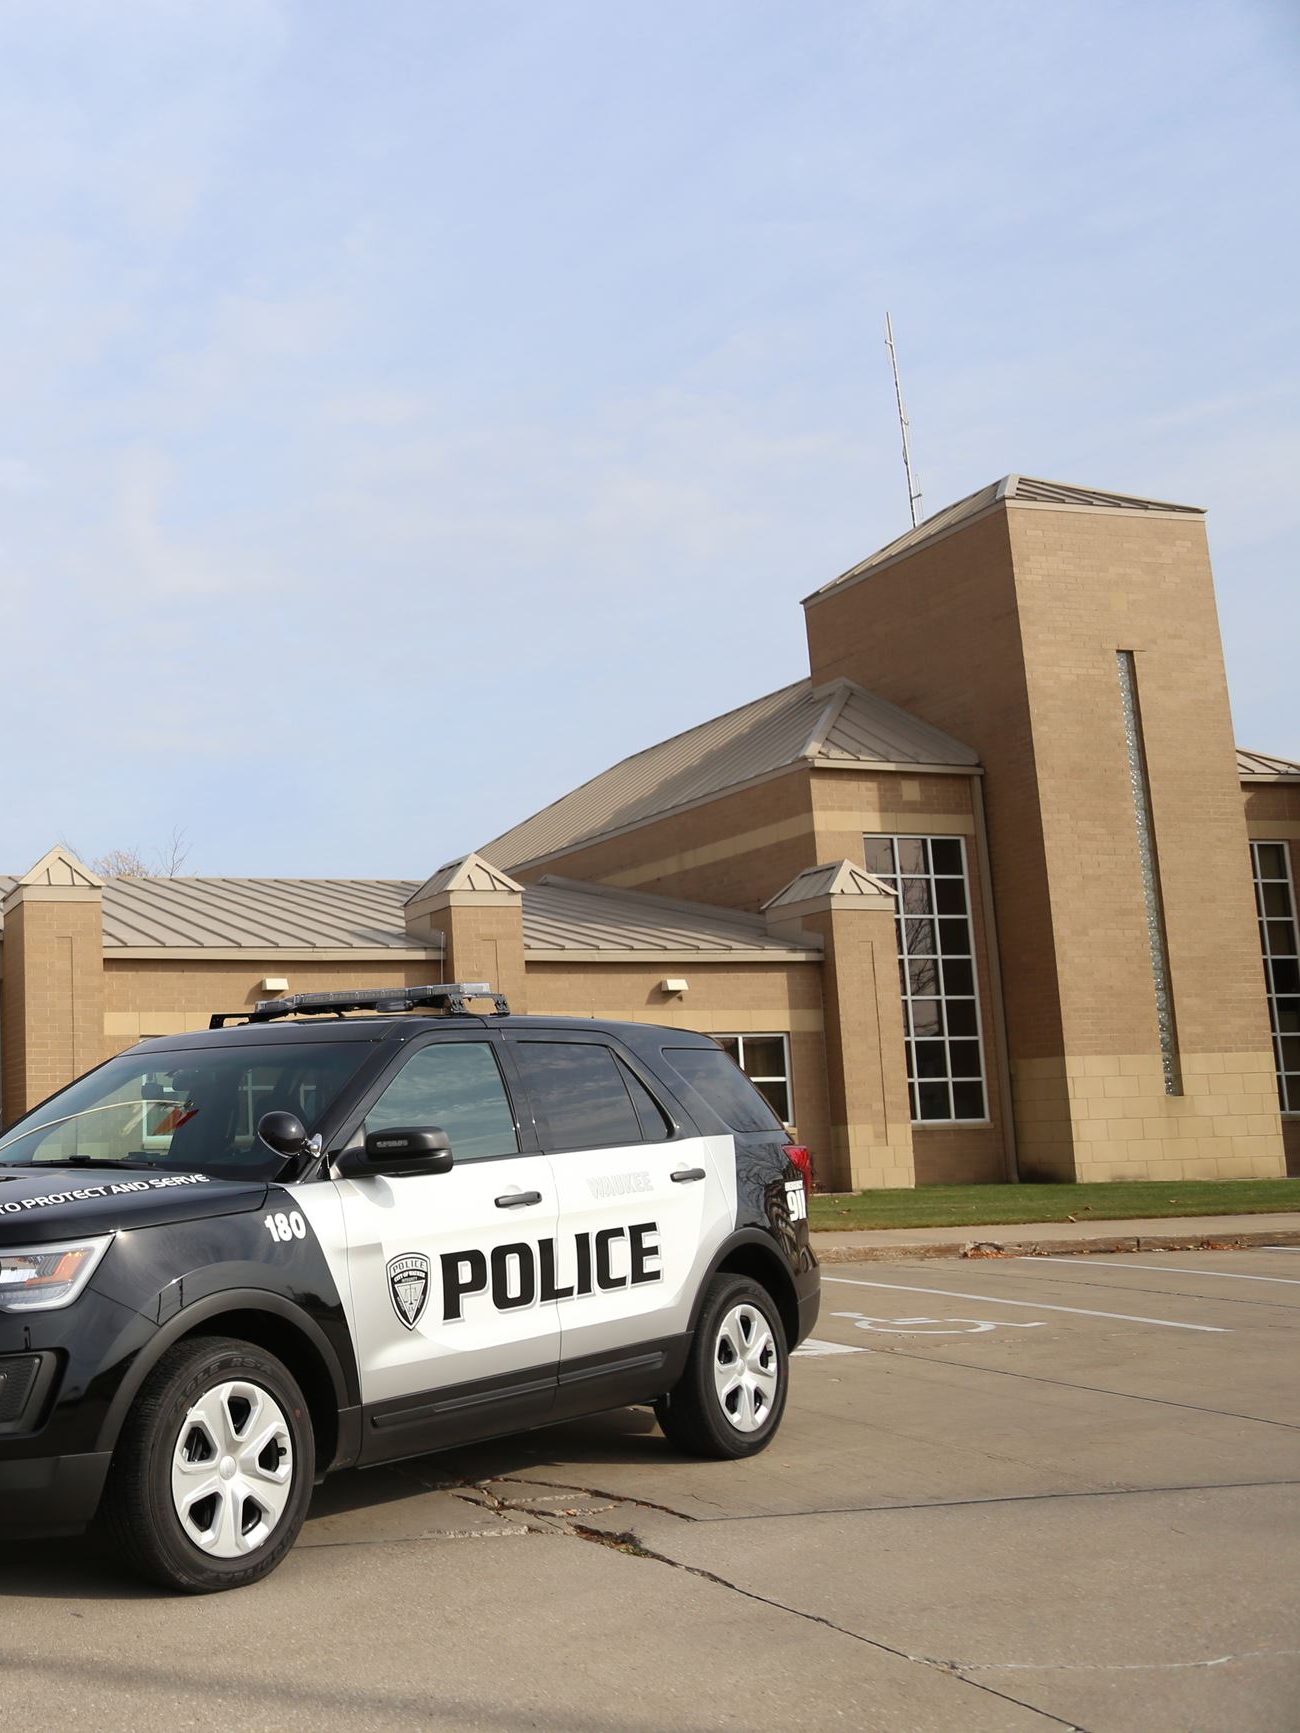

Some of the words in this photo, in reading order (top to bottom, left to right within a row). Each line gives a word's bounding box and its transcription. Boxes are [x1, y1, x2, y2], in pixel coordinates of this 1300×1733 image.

[23, 1185, 108, 1211] PROTECT
[111, 1180, 150, 1195] AND
[149, 1173, 211, 1189] SERVE
[586, 1171, 654, 1199] WAUKEE
[264, 1210, 307, 1243] 180
[392, 1259, 425, 1274] POLICE
[439, 1221, 663, 1323] POLICE
